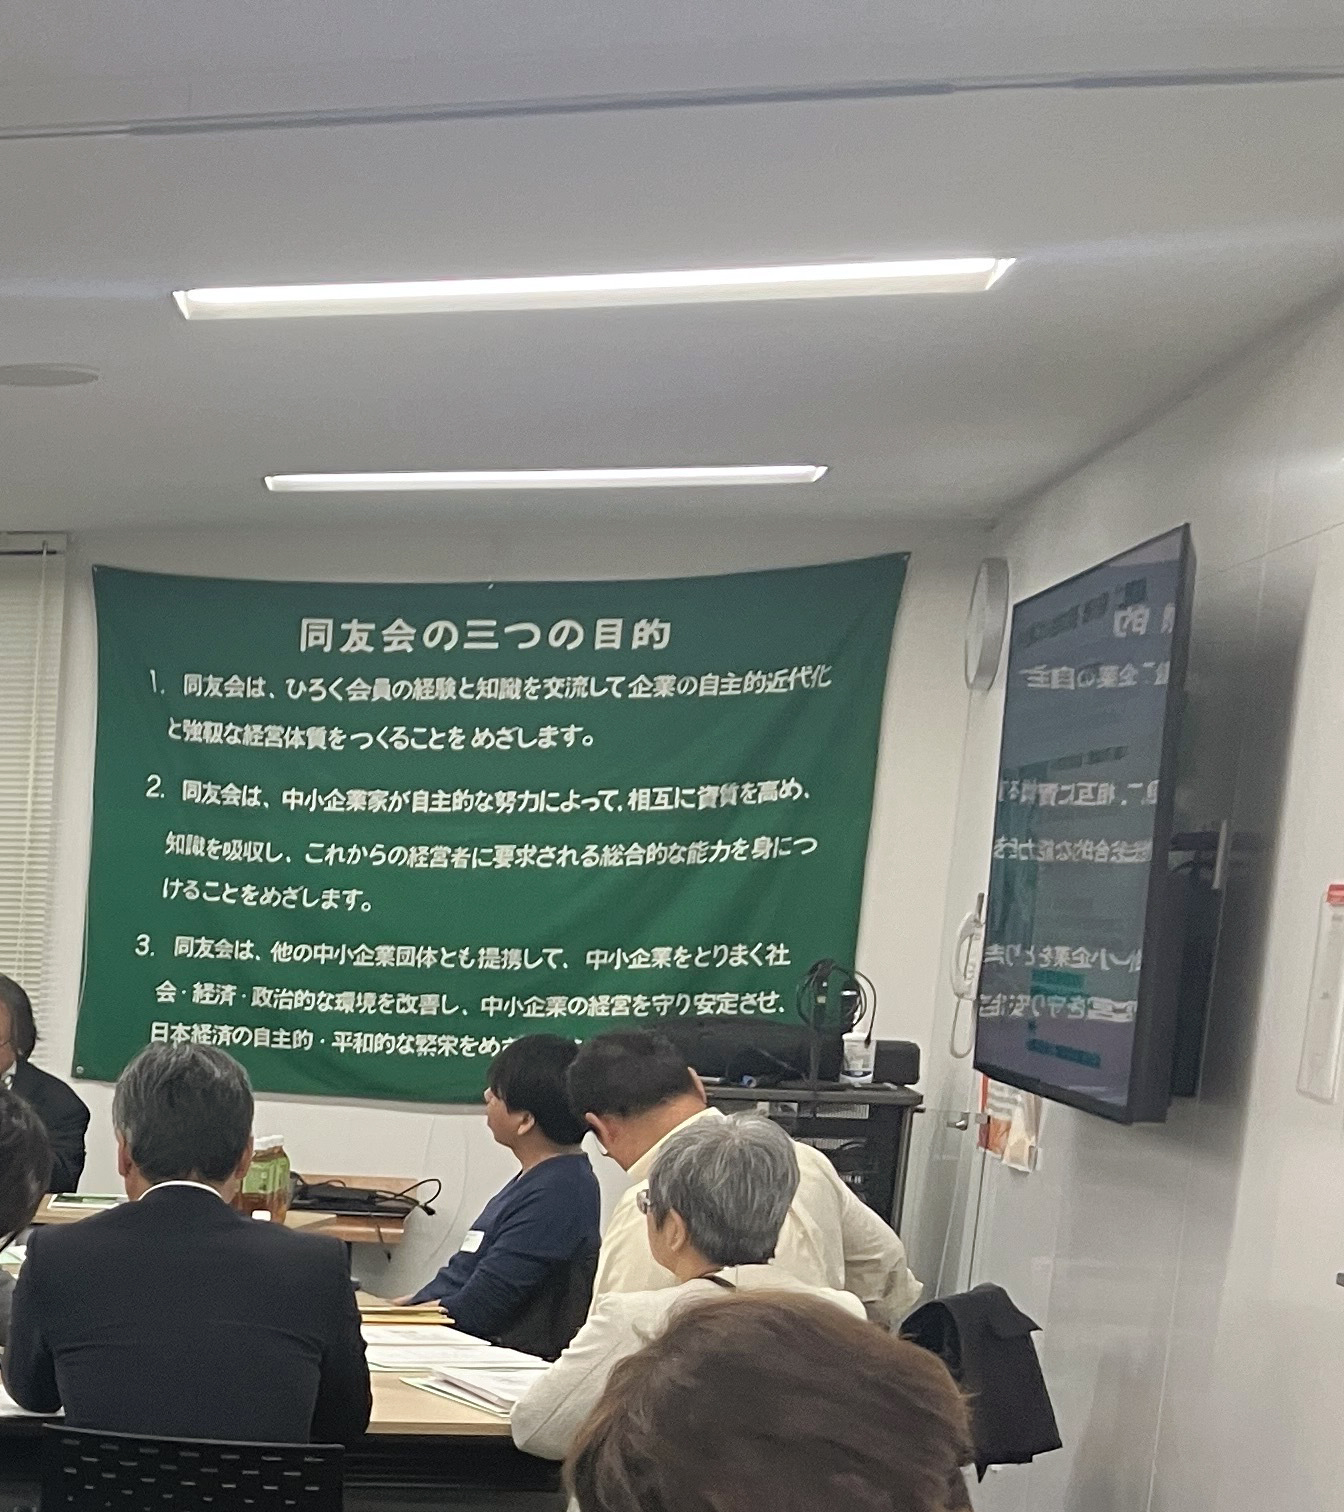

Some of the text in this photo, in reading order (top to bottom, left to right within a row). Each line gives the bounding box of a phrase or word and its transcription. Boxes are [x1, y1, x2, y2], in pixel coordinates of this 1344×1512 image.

[300, 617, 672, 653] 同友会の三つの目的
[163, 878, 372, 912] けることをめざします。
